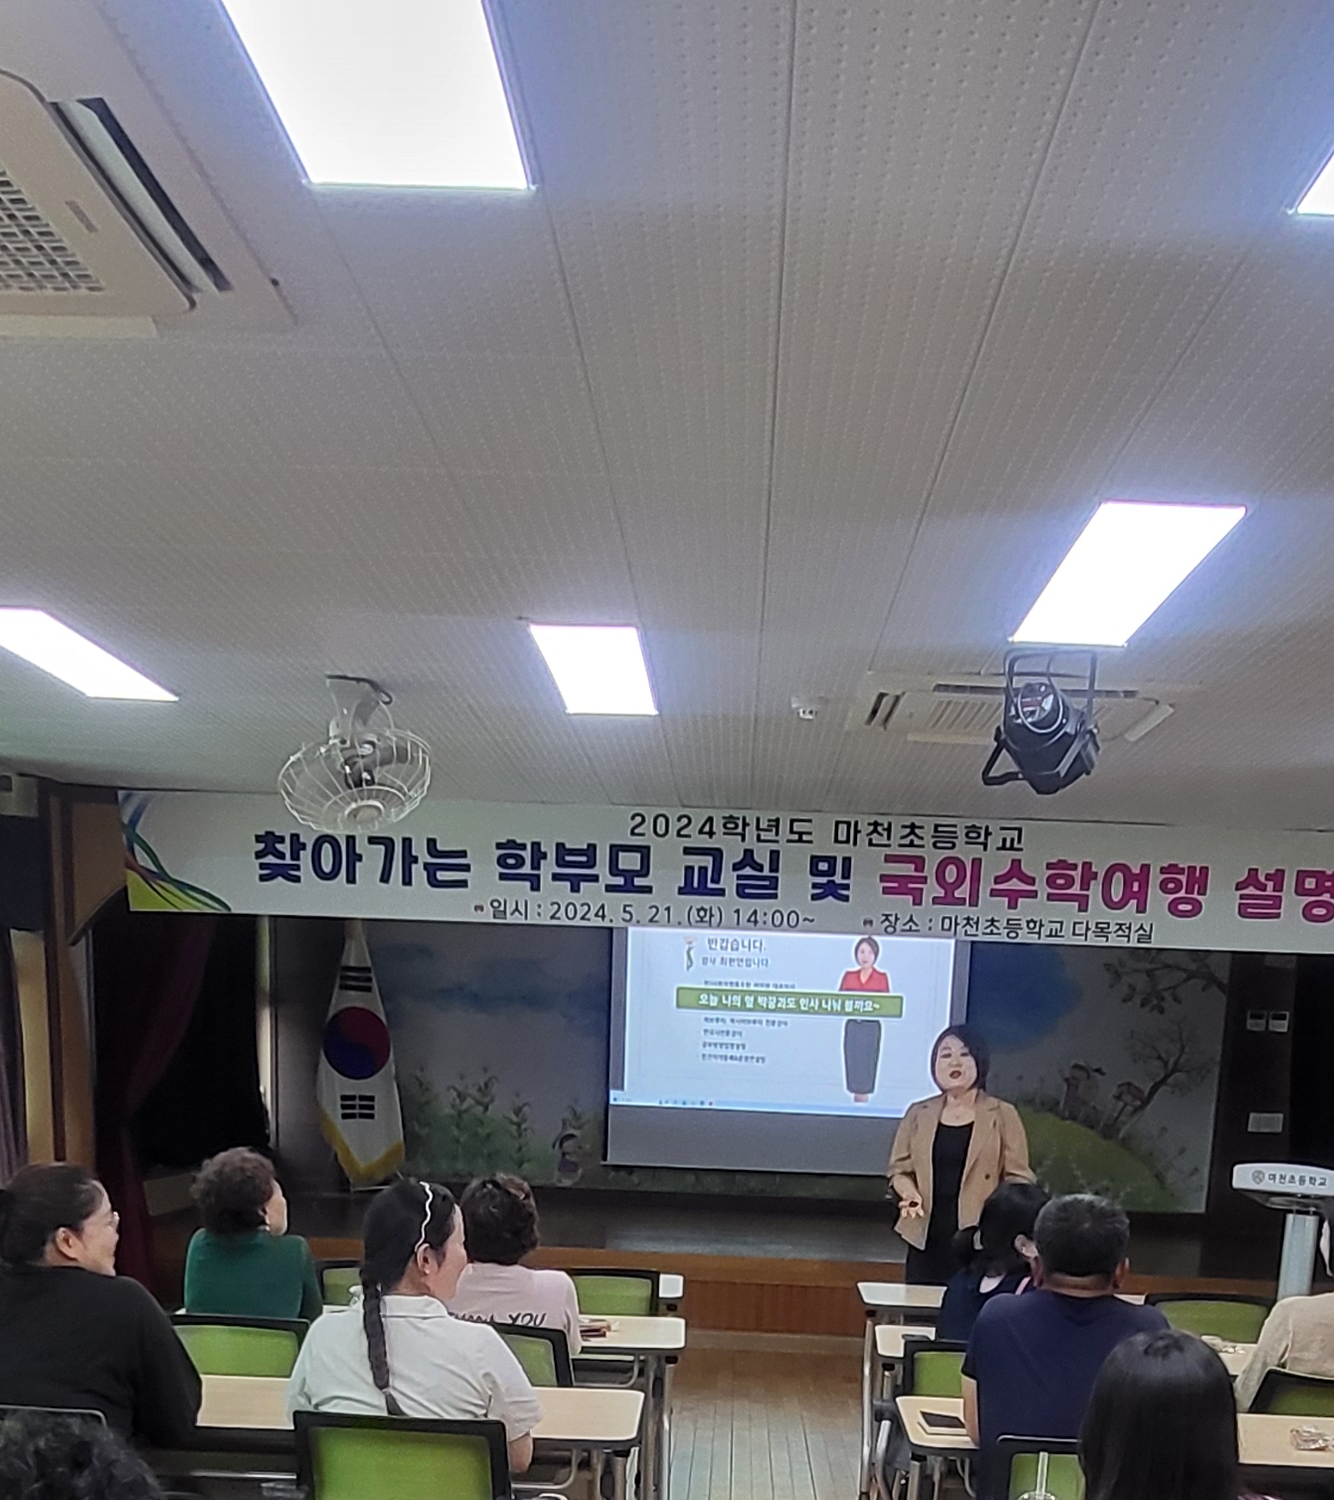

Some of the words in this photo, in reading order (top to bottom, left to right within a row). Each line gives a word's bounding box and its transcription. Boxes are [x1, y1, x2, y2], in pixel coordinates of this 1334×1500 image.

[629, 812, 814, 844] 2024학년도
[832, 819, 1024, 852] 마천초등학교
[253, 830, 472, 889] 찾아가는
[494, 838, 654, 894] 학부모
[677, 846, 781, 900] 교실
[809, 854, 853, 903] 및
[878, 853, 1210, 919] 국외수학여행
[489, 898, 529, 921] 일시
[549, 901, 614, 923] 2024.
[732, 907, 816, 929] 14:00~
[879, 912, 921, 935] 장소
[940, 914, 1066, 939] 마천초등학교
[1071, 919, 1154, 944] 다목적실
